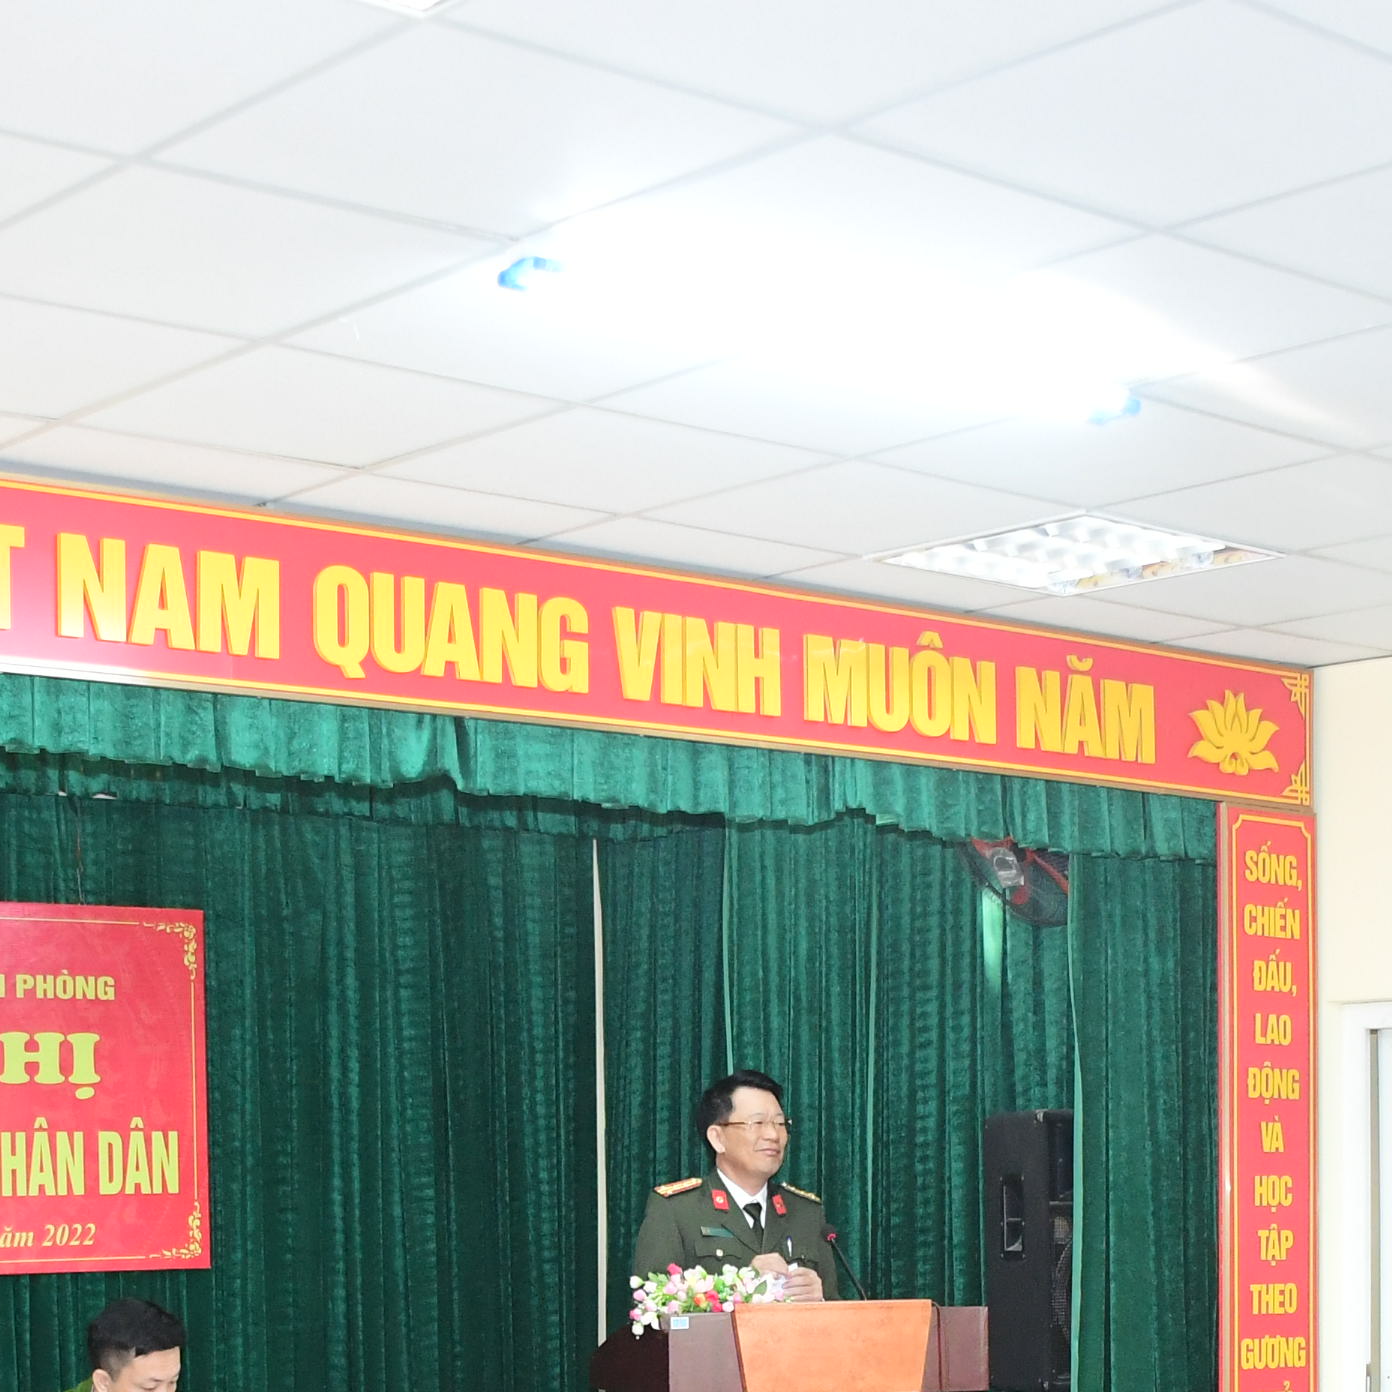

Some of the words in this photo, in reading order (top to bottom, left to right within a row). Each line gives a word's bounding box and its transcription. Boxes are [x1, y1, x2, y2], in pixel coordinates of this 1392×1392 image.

[57, 532, 280, 659] NAM
[313, 565, 589, 694] QUANG
[612, 606, 782, 717] VINH
[803, 630, 998, 744] MUÔN
[1016, 654, 1156, 764] NĂM
[1245, 841, 1302, 891] SỐNG,
[1244, 898, 1301, 939] CHIẾN
[16, 970, 115, 1000] PHÒNG
[1253, 949, 1297, 996] ĐẤU,
[1255, 1013, 1292, 1045] LAO
[1247, 1061, 1300, 1104] ĐỘNG
[1261, 1116, 1284, 1152] VÀ
[98, 1117, 179, 1195] DÂN
[1255, 1175, 1293, 1212] HỌC
[42, 1223, 96, 1246] 2022
[1258, 1224, 1293, 1266] TẬP
[1250, 1283, 1297, 1315] THEO
[1240, 1335, 1306, 1370] GƯƠNG
